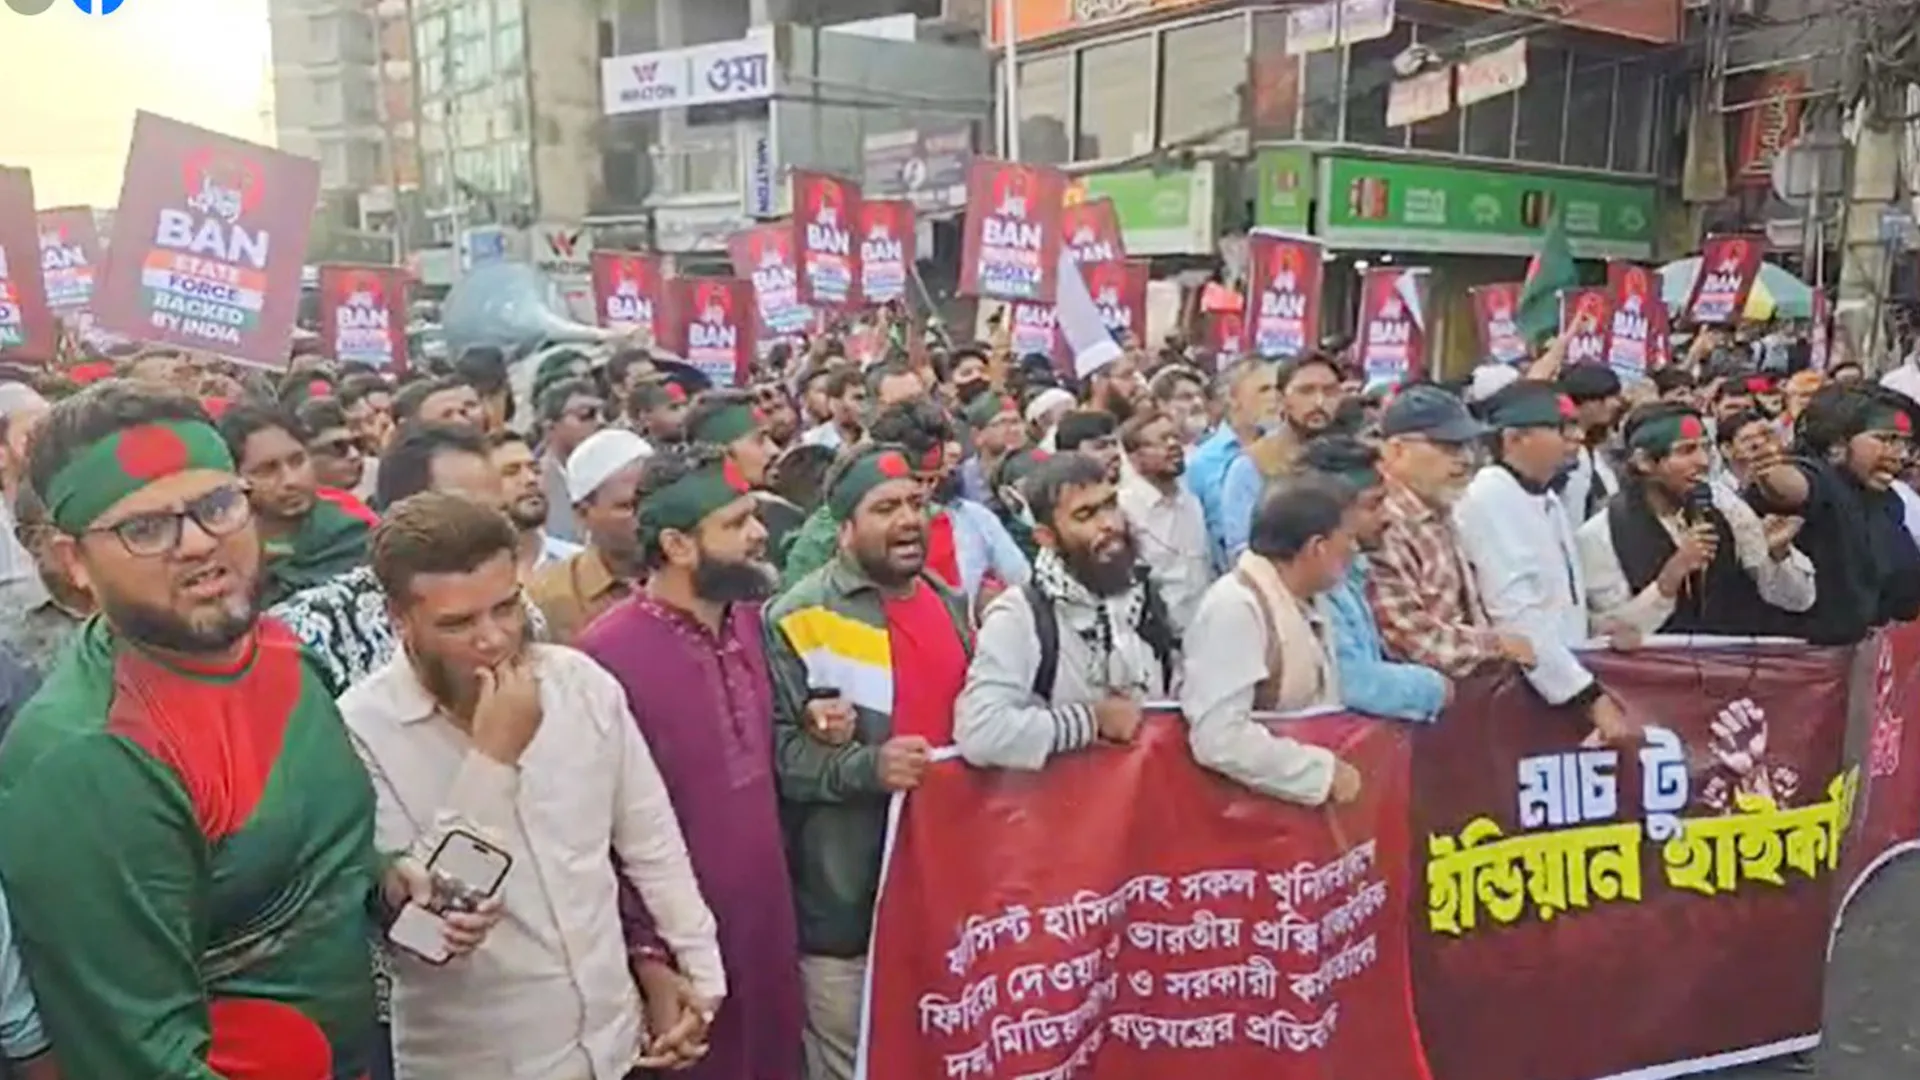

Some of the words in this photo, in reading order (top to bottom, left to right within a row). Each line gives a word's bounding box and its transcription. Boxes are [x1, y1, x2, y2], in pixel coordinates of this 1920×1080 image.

[156, 207, 270, 269] BAN
[806, 223, 850, 256] BAN
[982, 216, 1042, 250] BAN
[41, 244, 88, 270] AN
[173, 252, 241, 282] STATE
[861, 240, 902, 262] BAN
[169, 274, 239, 300] FORCE
[1703, 273, 1743, 292] BAN
[154, 291, 245, 325] BACKED
[336, 305, 389, 329] BAN
[606, 294, 653, 320] BAN
[1260, 291, 1307, 317] BAN
[151, 310, 182, 334] BY
[182, 318, 241, 345] INDIA
[689, 322, 737, 349] BAN
[1369, 320, 1410, 342] BAN
[1613, 310, 1649, 341] BAN
[1638, 724, 1690, 841] টু
[1178, 868, 1257, 901] সকল
[1427, 817, 1641, 936] ইন্ডিয়ান
[1127, 909, 1242, 954] ভারতীয়
[1252, 910, 1320, 955] প্রক্সি
[1126, 968, 1154, 997] ও
[1163, 954, 1280, 1000] সরকারী
[1109, 1011, 1237, 1050] ষড়যন্ত্রের
